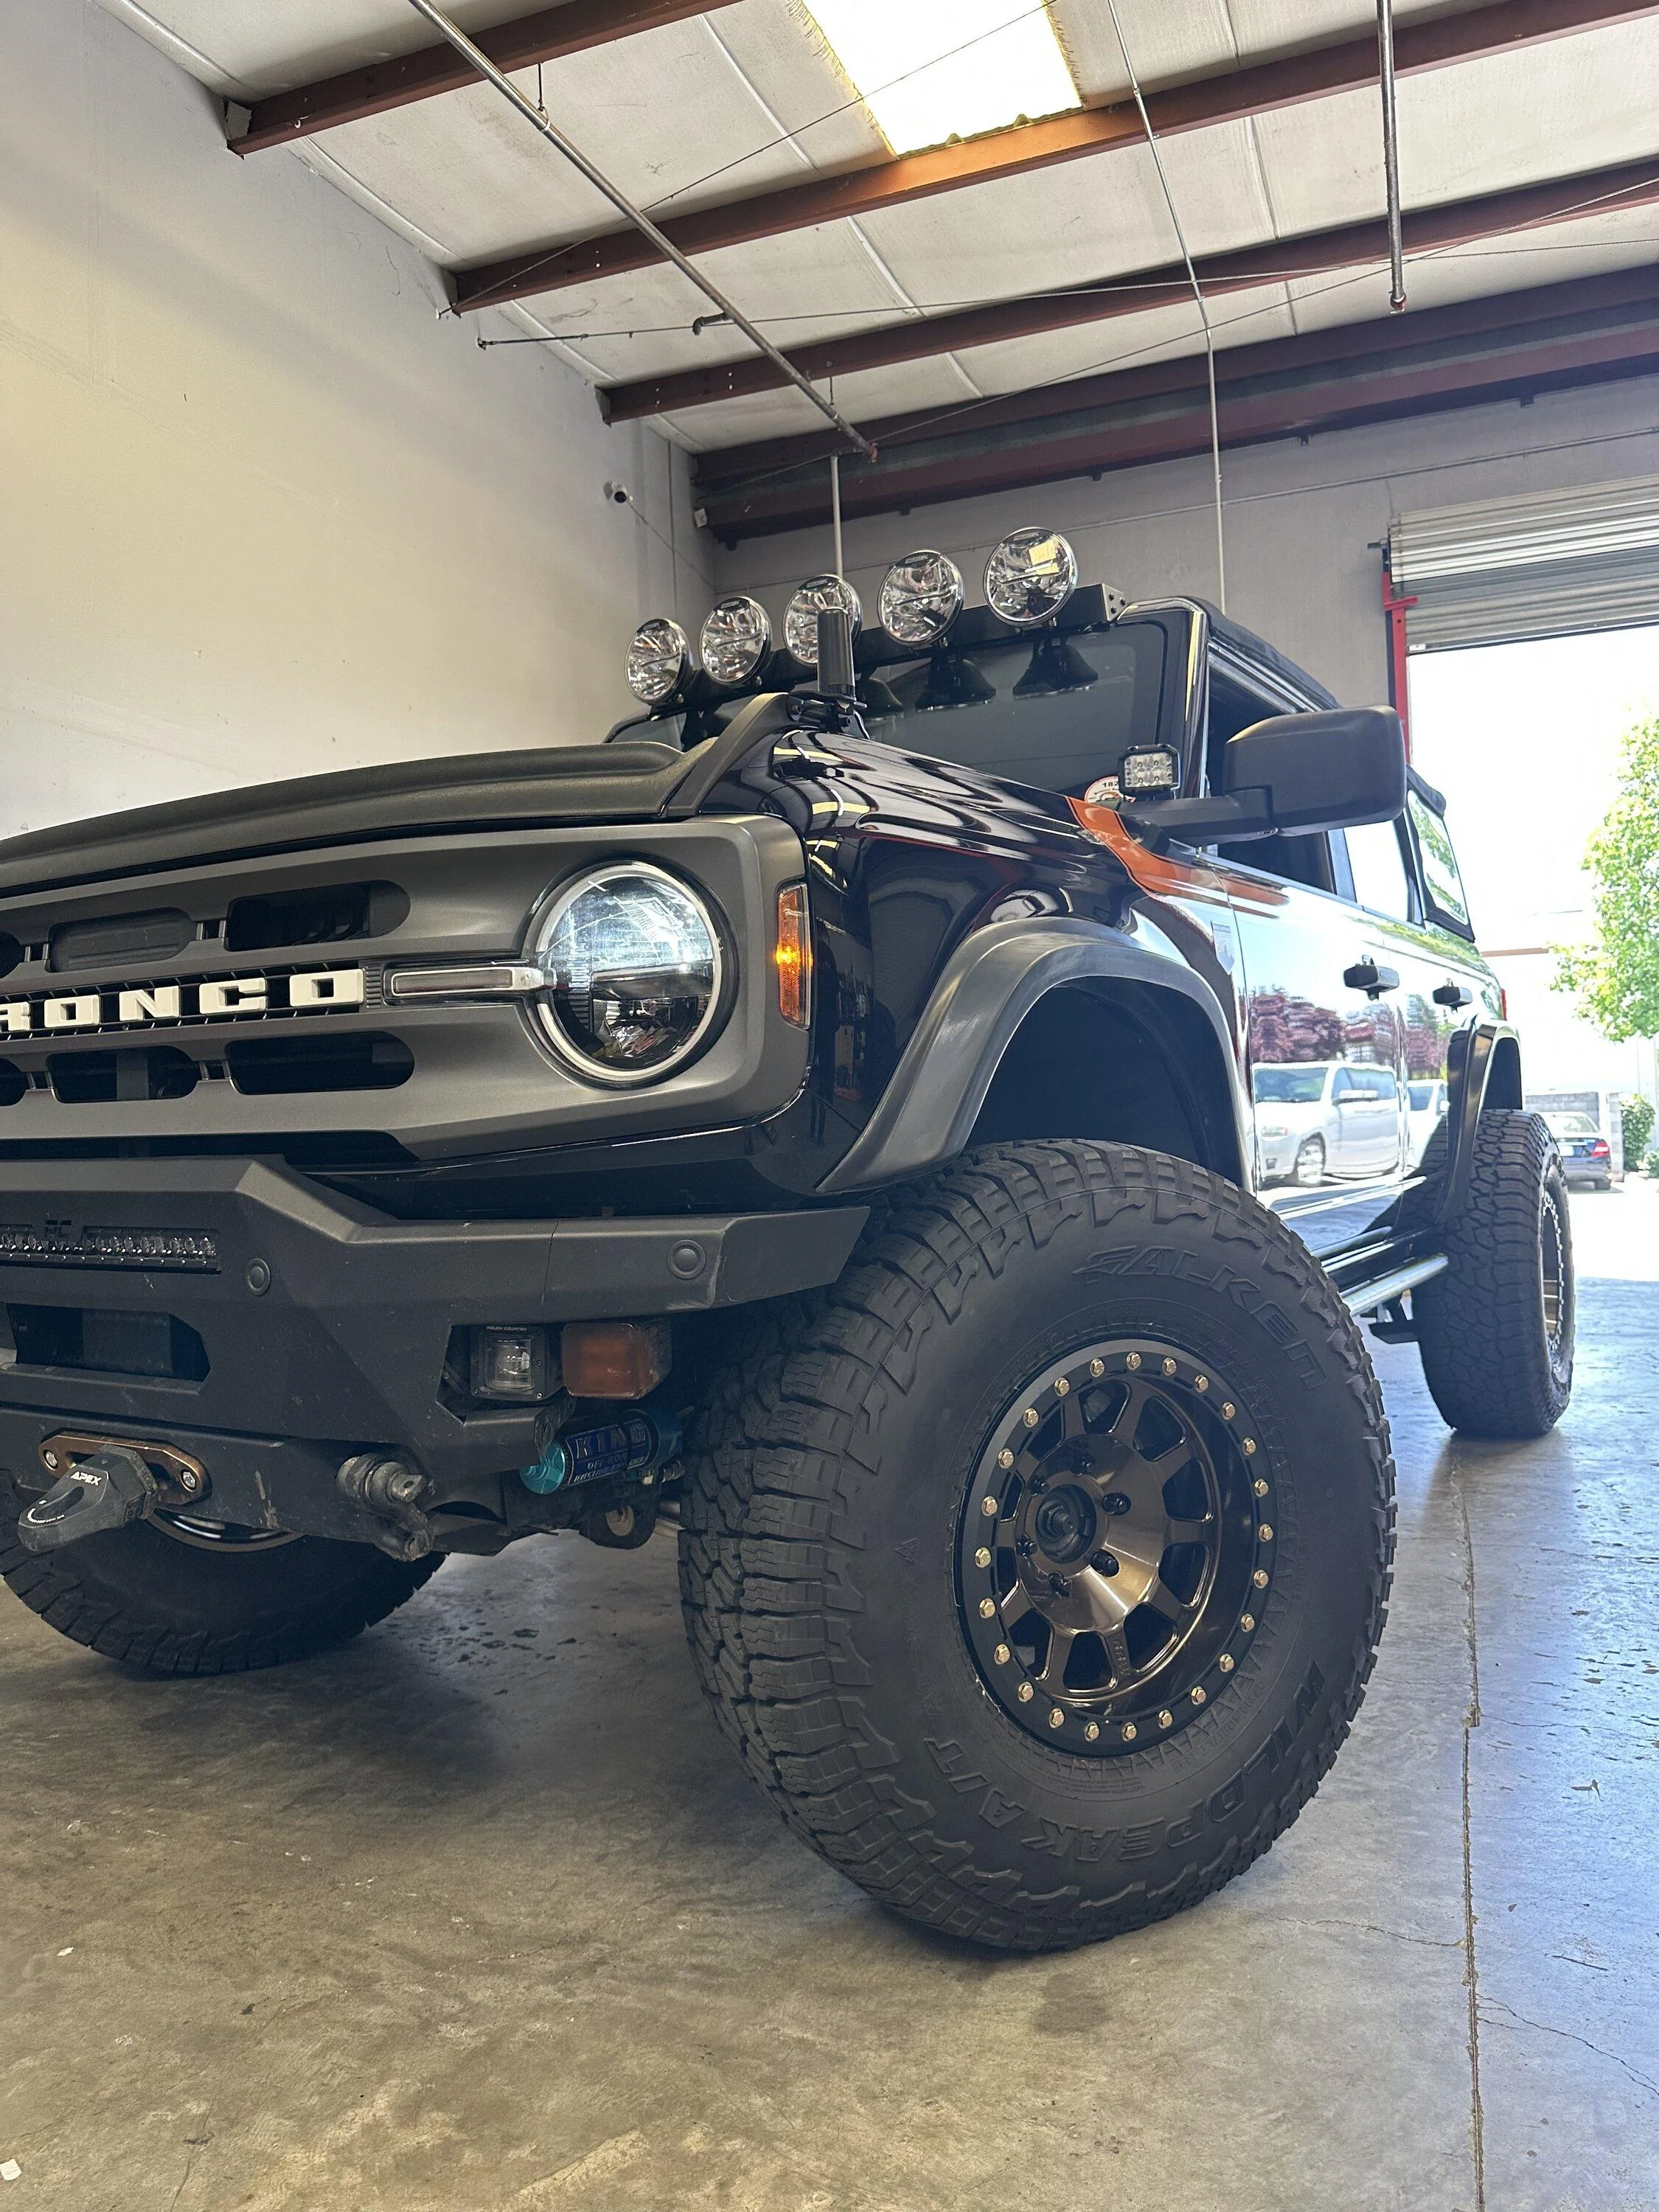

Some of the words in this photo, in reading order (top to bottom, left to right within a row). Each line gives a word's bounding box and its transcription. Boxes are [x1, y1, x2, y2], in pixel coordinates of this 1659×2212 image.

[1072, 1245, 1326, 1389] FALKEN
[70, 1471, 102, 1486] APEX
[576, 1422, 647, 1459] KING
[1021, 1658, 1326, 1863] WILDPEAK
